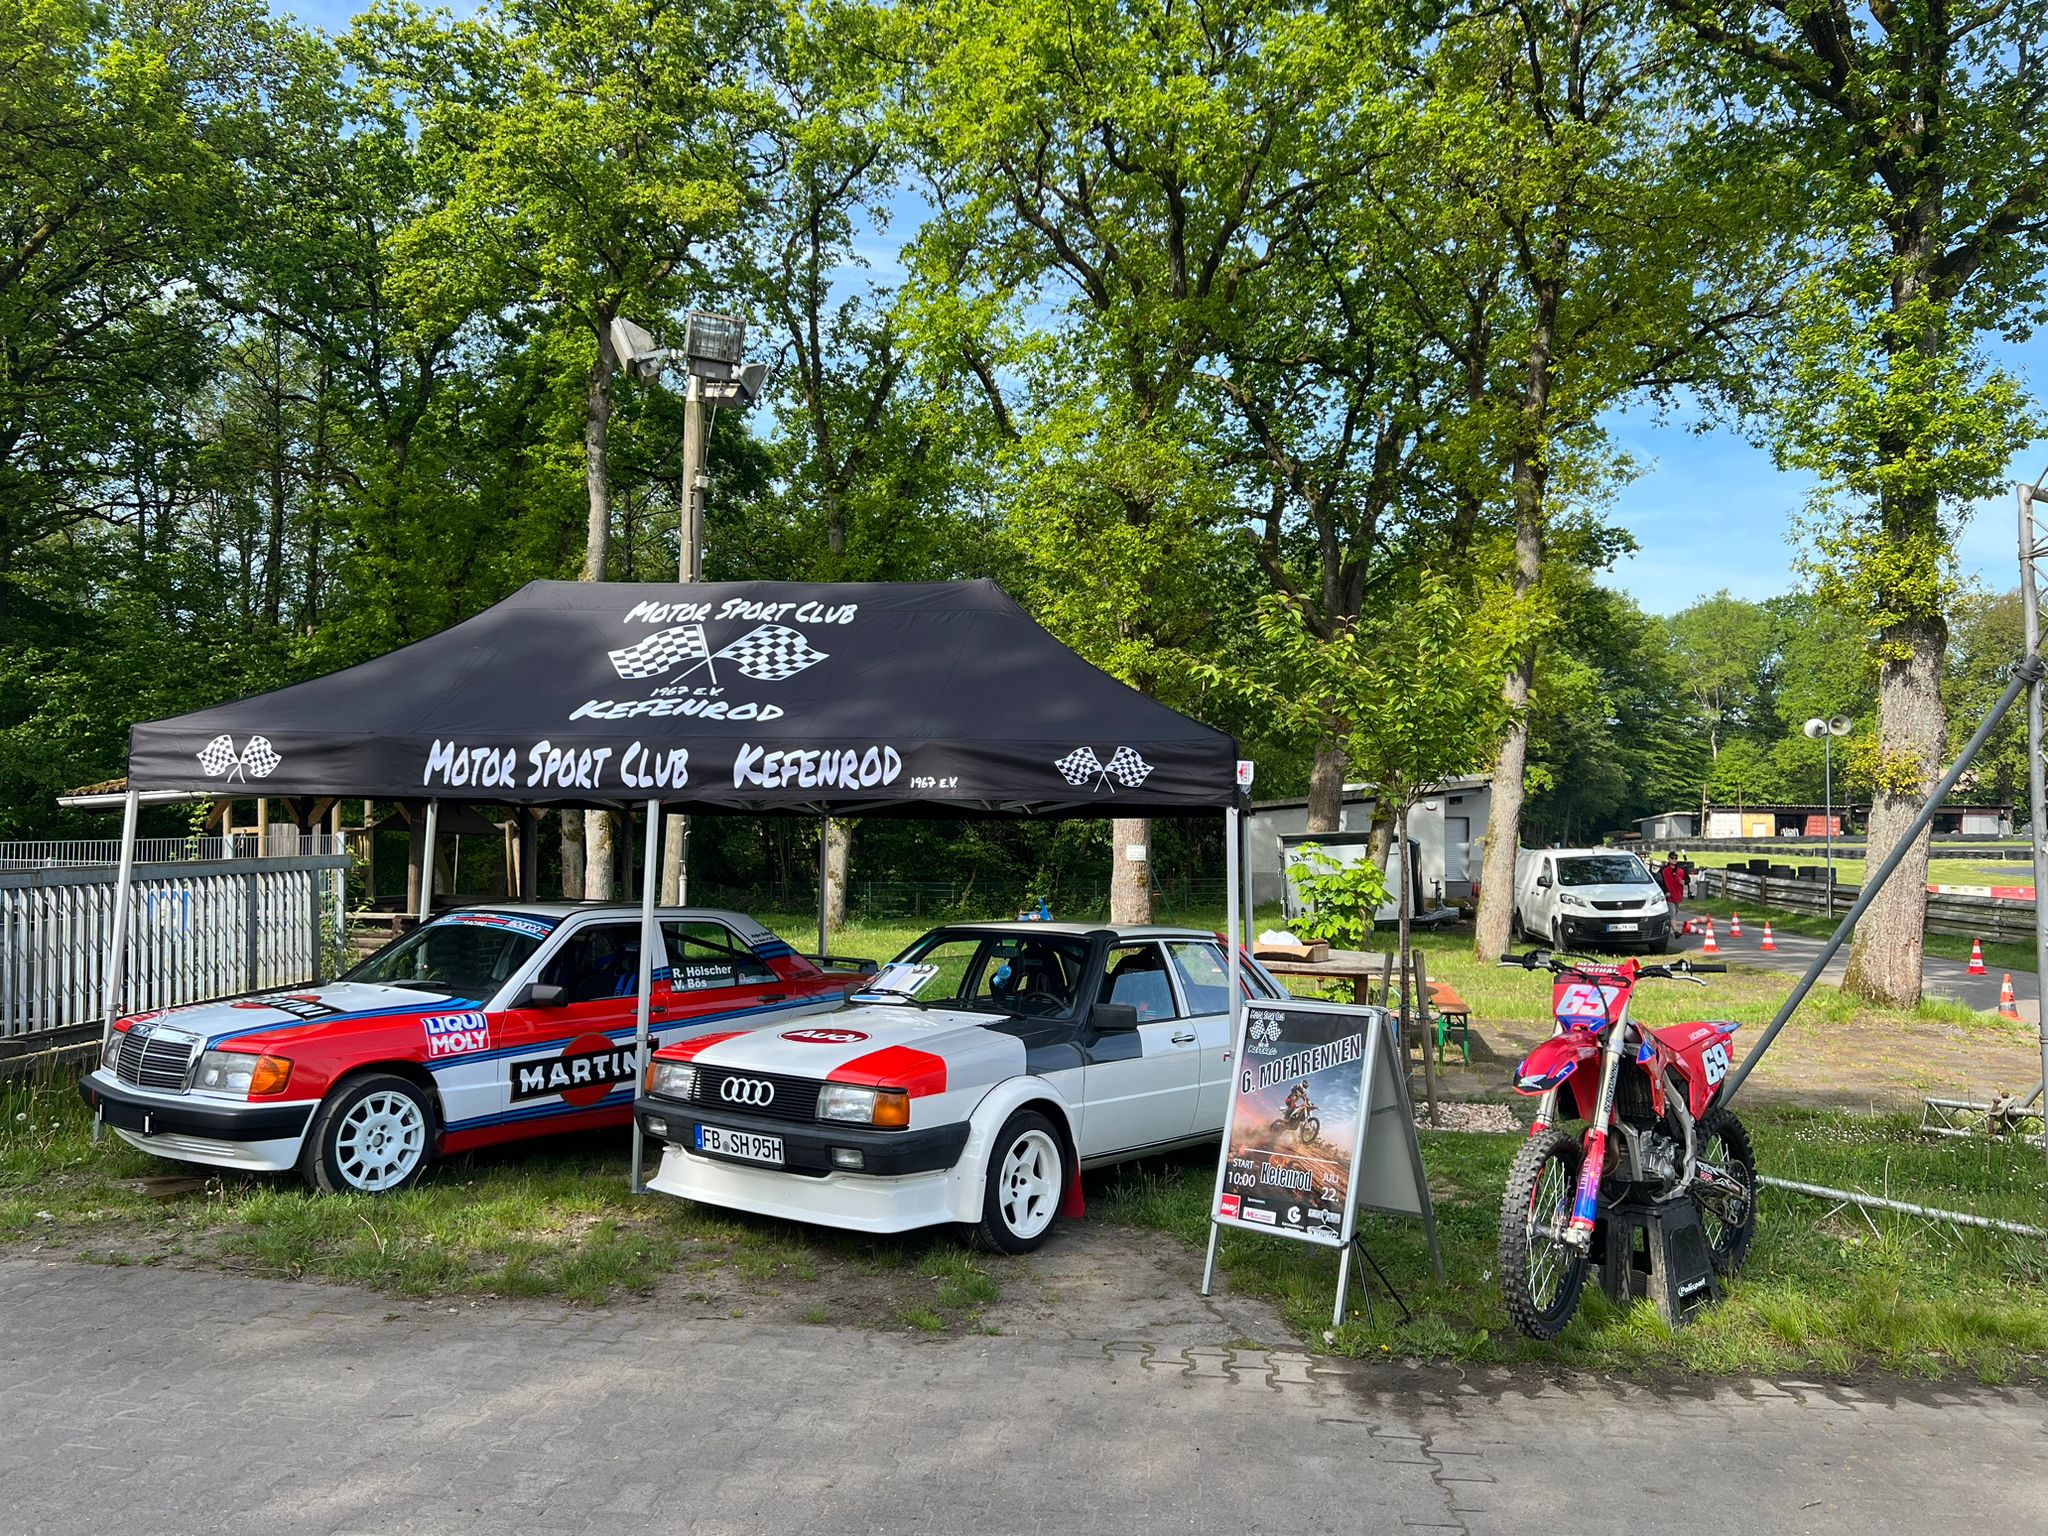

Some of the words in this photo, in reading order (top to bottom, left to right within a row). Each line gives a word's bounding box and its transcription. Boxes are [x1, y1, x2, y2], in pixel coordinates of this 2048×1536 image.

[650, 686, 689, 697] 1967
[910, 776, 937, 789] 1967
[672, 968, 685, 978] R.
[686, 964, 732, 978] Hölscher
[674, 979, 685, 990] V.
[687, 978, 707, 989] Bös
[1555, 984, 1619, 1016] 69
[425, 1013, 484, 1034] LIQUI
[431, 1030, 487, 1055] MOLY
[1241, 1068, 1256, 1095] 6.
[1259, 1033, 1362, 1090] MOFARENNEN
[1701, 1043, 1729, 1086] 69
[703, 1128, 721, 1150] FB
[730, 1133, 750, 1156] SH
[752, 1137, 783, 1161] 95H
[1232, 1158, 1254, 1170] START
[1227, 1171, 1256, 1188] 10:00
[1320, 1186, 1340, 1203] 22.
